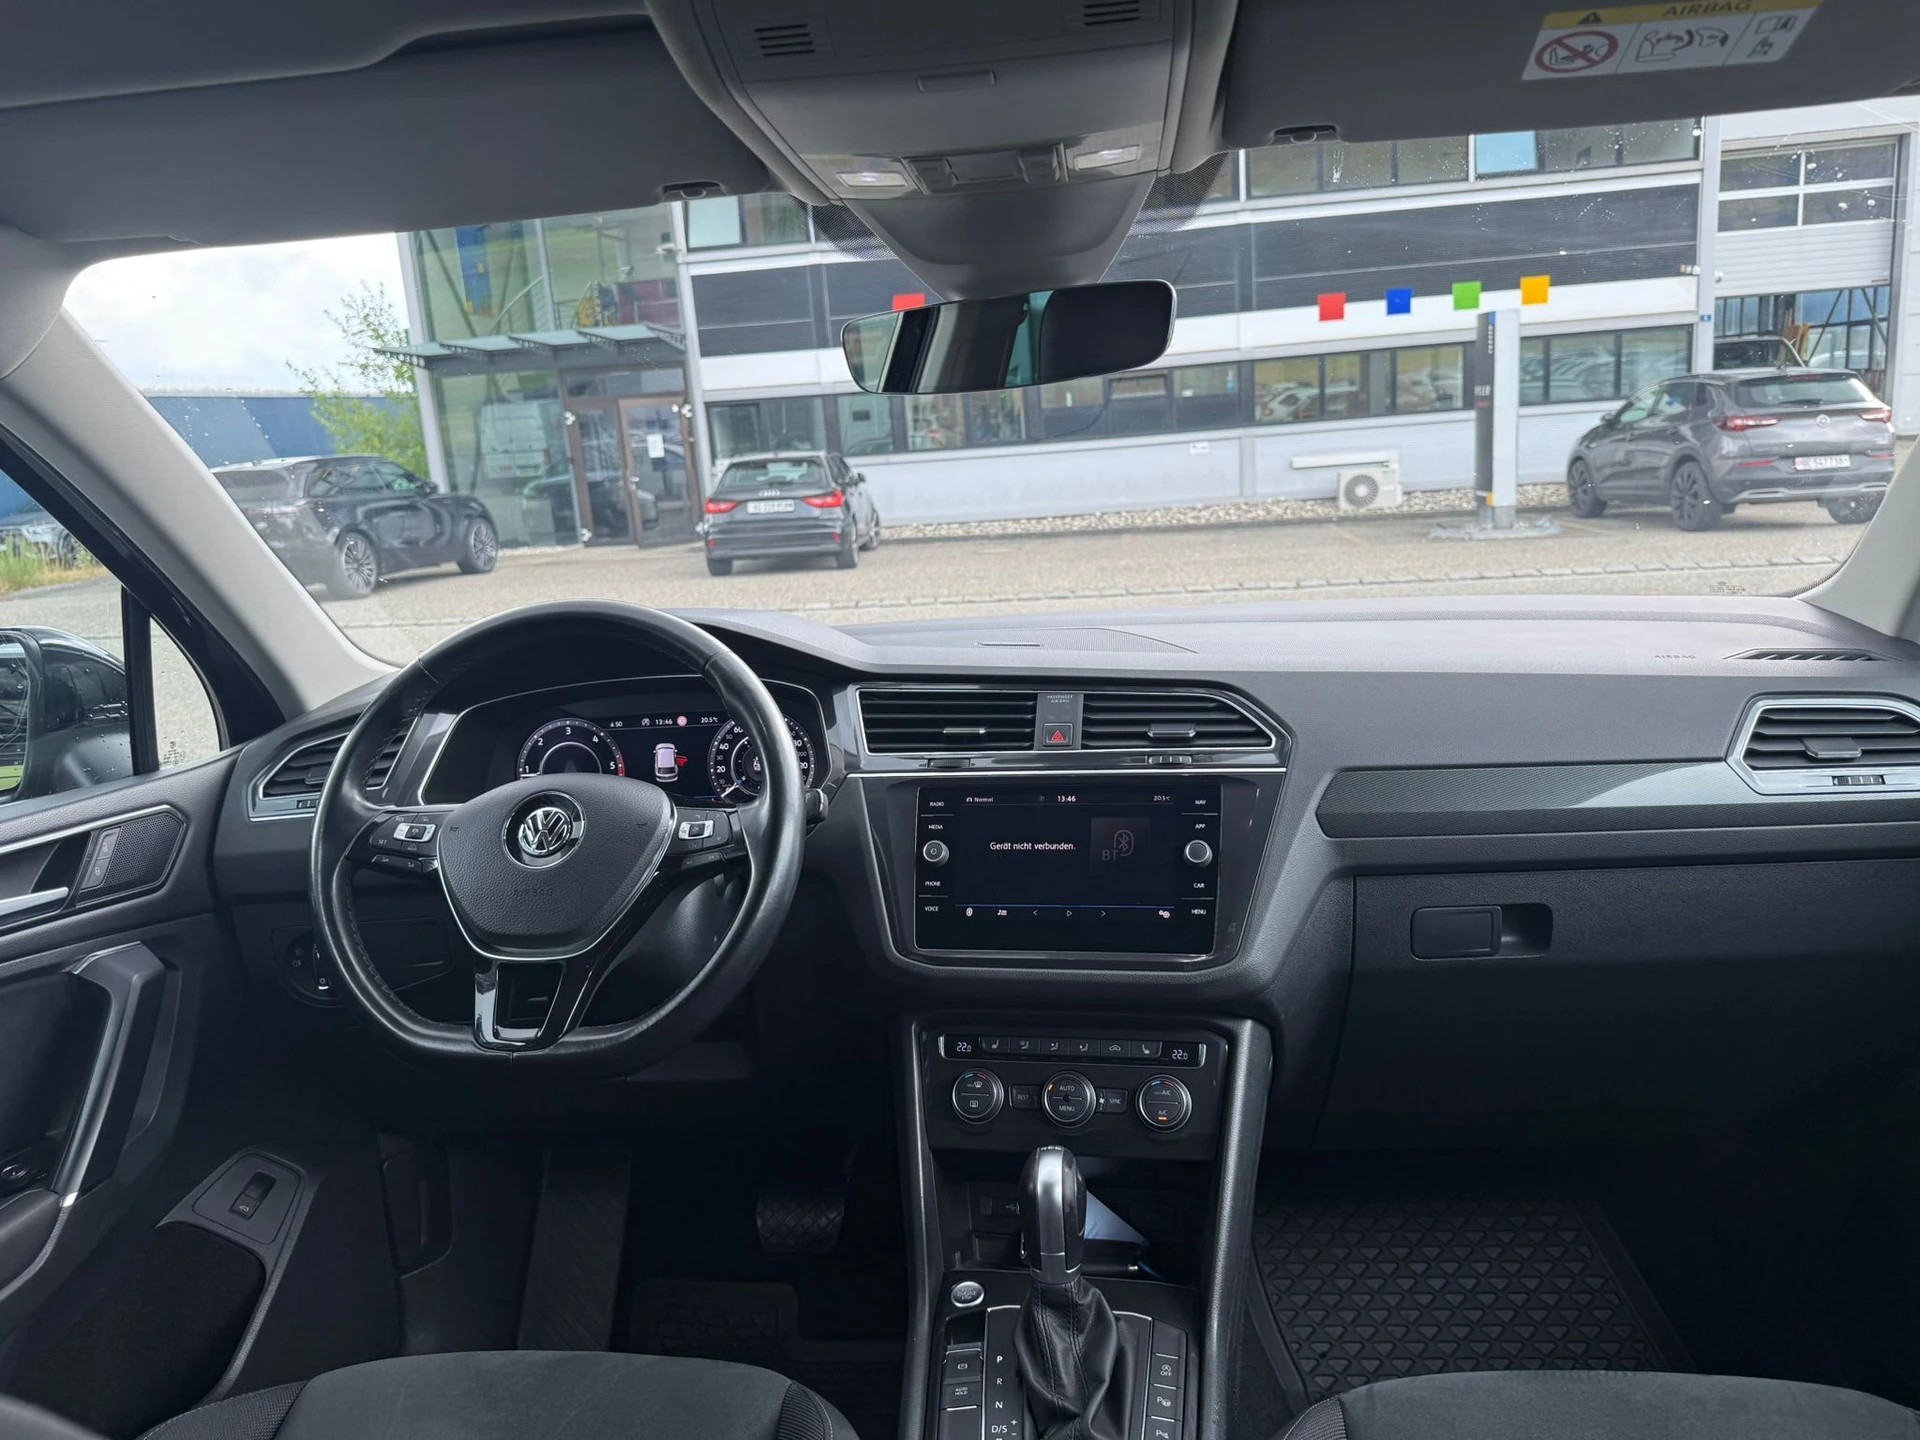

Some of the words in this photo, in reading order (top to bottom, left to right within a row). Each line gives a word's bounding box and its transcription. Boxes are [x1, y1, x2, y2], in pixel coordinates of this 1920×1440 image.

[1662, 1, 1751, 17] AIRBAG
[565, 727, 571, 735] 3
[537, 737, 544, 746] 2
[592, 735, 599, 743] 4
[719, 742, 729, 750] 40
[609, 761, 616, 770] 5
[716, 765, 726, 773] 20
[1057, 795, 1076, 803] 13:46
[989, 841, 1012, 850] Gerät
[1013, 841, 1032, 850] nicht
[1034, 841, 1076, 850] verbunden.
[1101, 849, 1119, 861] BT
[996, 1355, 1003, 1363] P
[996, 1377, 1003, 1385] R
[995, 1401, 1003, 1409] N
[991, 1425, 1008, 1433] D/S
